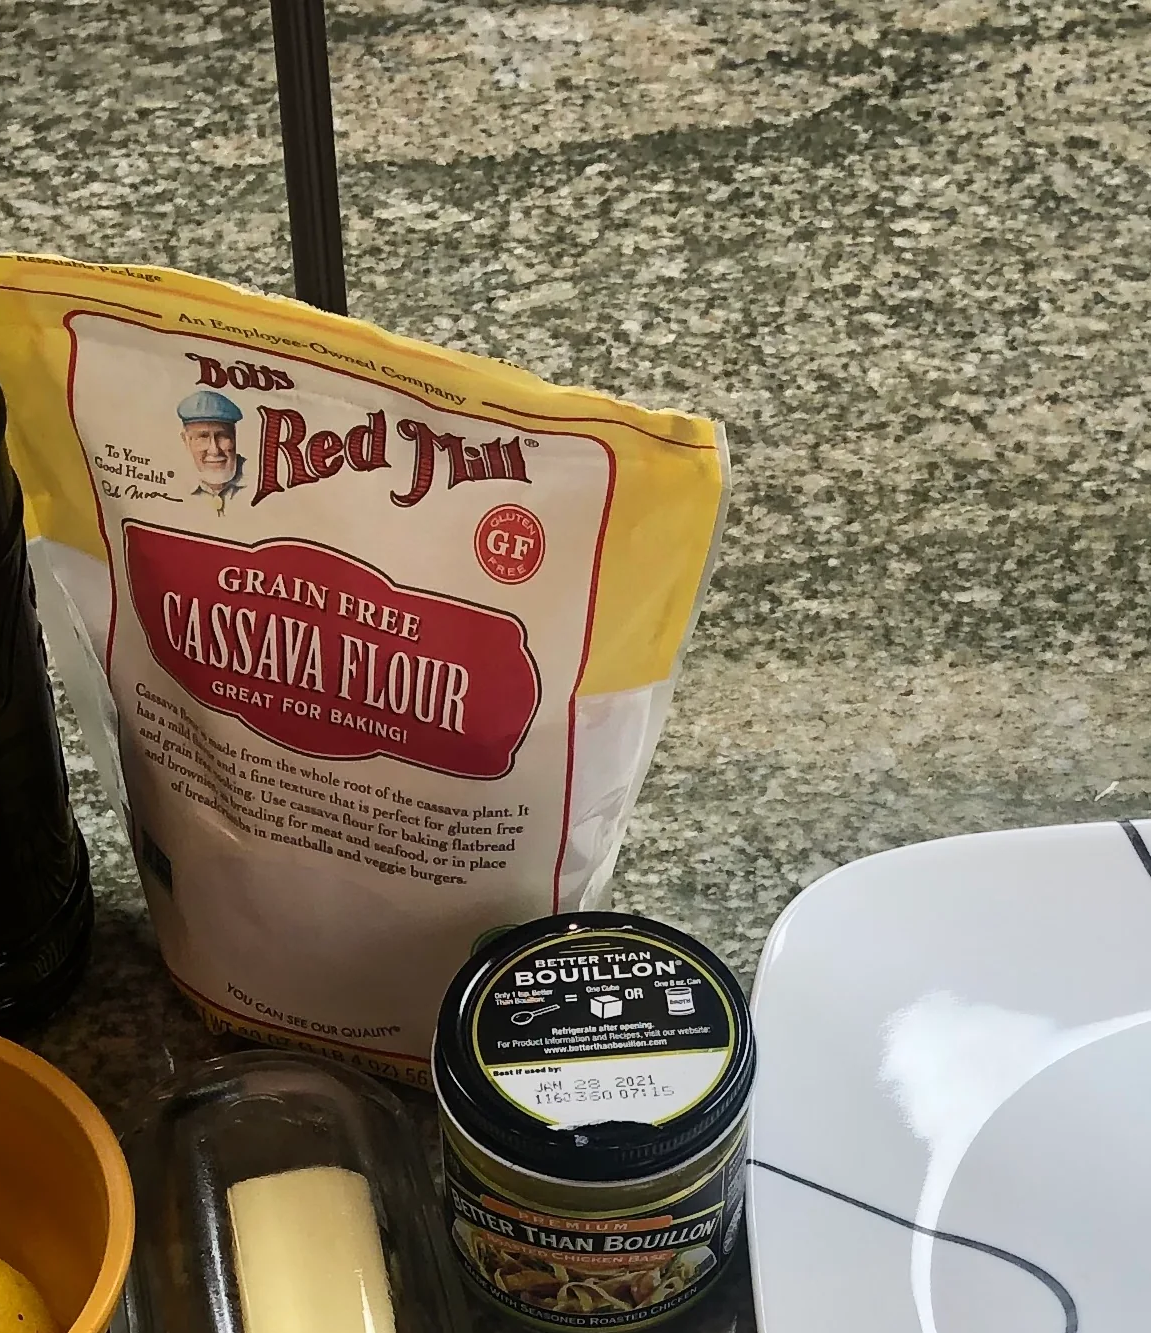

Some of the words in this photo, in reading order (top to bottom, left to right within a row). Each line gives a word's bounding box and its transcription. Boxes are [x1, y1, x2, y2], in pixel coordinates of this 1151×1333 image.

[98, 265, 163, 283] Package
[178, 312, 206, 327] An
[210, 318, 378, 372] Employee-Owned
[381, 366, 468, 406] Company
[94, 456, 123, 475] Good
[105, 444, 120, 459] To
[122, 448, 151, 465] Your
[250, 405, 393, 508] Red
[490, 512, 536, 536] GLUTEN
[487, 529, 535, 561] GF
[488, 556, 527, 577] FREE
[217, 565, 329, 611] GRAIN
[337, 591, 421, 643] FREE
[163, 590, 325, 693] CASSAVA
[337, 633, 470, 735] FLOUR
[211, 680, 275, 711] GREAT
[283, 697, 321, 722] FOR
[330, 709, 408, 745] BAKING!
[135, 682, 178, 715] Cassava
[208, 737, 237, 758] made
[240, 748, 273, 768] from
[276, 758, 297, 775] the
[300, 766, 340, 787] whole
[343, 779, 372, 795] root
[375, 786, 391, 800] of
[392, 790, 413, 807] the
[416, 800, 469, 818] cassava
[473, 805, 513, 821] plant.
[517, 804, 530, 817] It
[136, 701, 155, 722] has
[158, 717, 166, 728] a
[168, 721, 190, 741] mild
[217, 759, 236, 776] and
[239, 769, 247, 780] a
[250, 769, 276, 786] fine
[279, 778, 326, 800] texture
[329, 792, 355, 810] that
[358, 800, 370, 814] is
[373, 806, 420, 827] perfect
[424, 816, 444, 831] for
[448, 822, 492, 837] gluten
[497, 822, 524, 835] free
[139, 725, 162, 744] and
[162, 738, 193, 760] grain
[261, 790, 287, 807] Use
[290, 801, 339, 823] cassava
[342, 813, 375, 832] flour
[378, 823, 398, 838] for
[401, 828, 449, 851] baking
[452, 839, 515, 852] flatbread
[145, 749, 165, 766] and
[230, 796, 285, 827] breading
[288, 815, 308, 831] for
[311, 824, 343, 840] meat
[346, 832, 370, 848] and
[374, 841, 429, 864] seafood,
[432, 856, 449, 866] or
[452, 855, 466, 868] in
[469, 857, 507, 872] place
[170, 781, 184, 794] of
[254, 824, 267, 839] in
[270, 832, 334, 855] meatballs
[336, 847, 362, 863] and
[364, 855, 407, 875] veggie
[410, 864, 468, 885] burgers.
[535, 955, 599, 968] BETTER
[603, 951, 651, 964] THAN
[624, 987, 644, 1000] OR
[227, 982, 253, 1006] YOU
[255, 1003, 284, 1021] CAN
[287, 1015, 307, 1029] SEE
[311, 1022, 338, 1037] OUR
[497, 1040, 510, 1048] For
[512, 1038, 543, 1048] Product
[544, 1035, 590, 1045] Information
[592, 1033, 607, 1042] and
[609, 1030, 643, 1041] Recipes,
[644, 1029, 662, 1038] visit
[663, 1028, 676, 1037] our
[551, 1026, 597, 1036] Refrigerate
[599, 1023, 618, 1033] after
[620, 1021, 654, 1031] opening.
[544, 1038, 668, 1054] www.betterthanbouillon.com
[405, 1067, 429, 1086] 56
[493, 1069, 514, 1077] Best
[524, 1067, 546, 1075] used
[535, 1080, 563, 1093] JAN
[615, 1074, 656, 1088] 2021
[451, 1187, 515, 1237] BETTER
[520, 1224, 593, 1252] THAN
[603, 1217, 717, 1252] BOUILLON
[517, 1209, 628, 1231] PREMIUM
[551, 1252, 624, 1263] CHICKEN
[627, 1253, 668, 1263] BASE
[490, 1288, 517, 1308] WITH
[520, 1303, 586, 1325] SEASONED
[590, 1311, 648, 1326] ROASTED
[650, 1287, 697, 1315] CHICKEN
